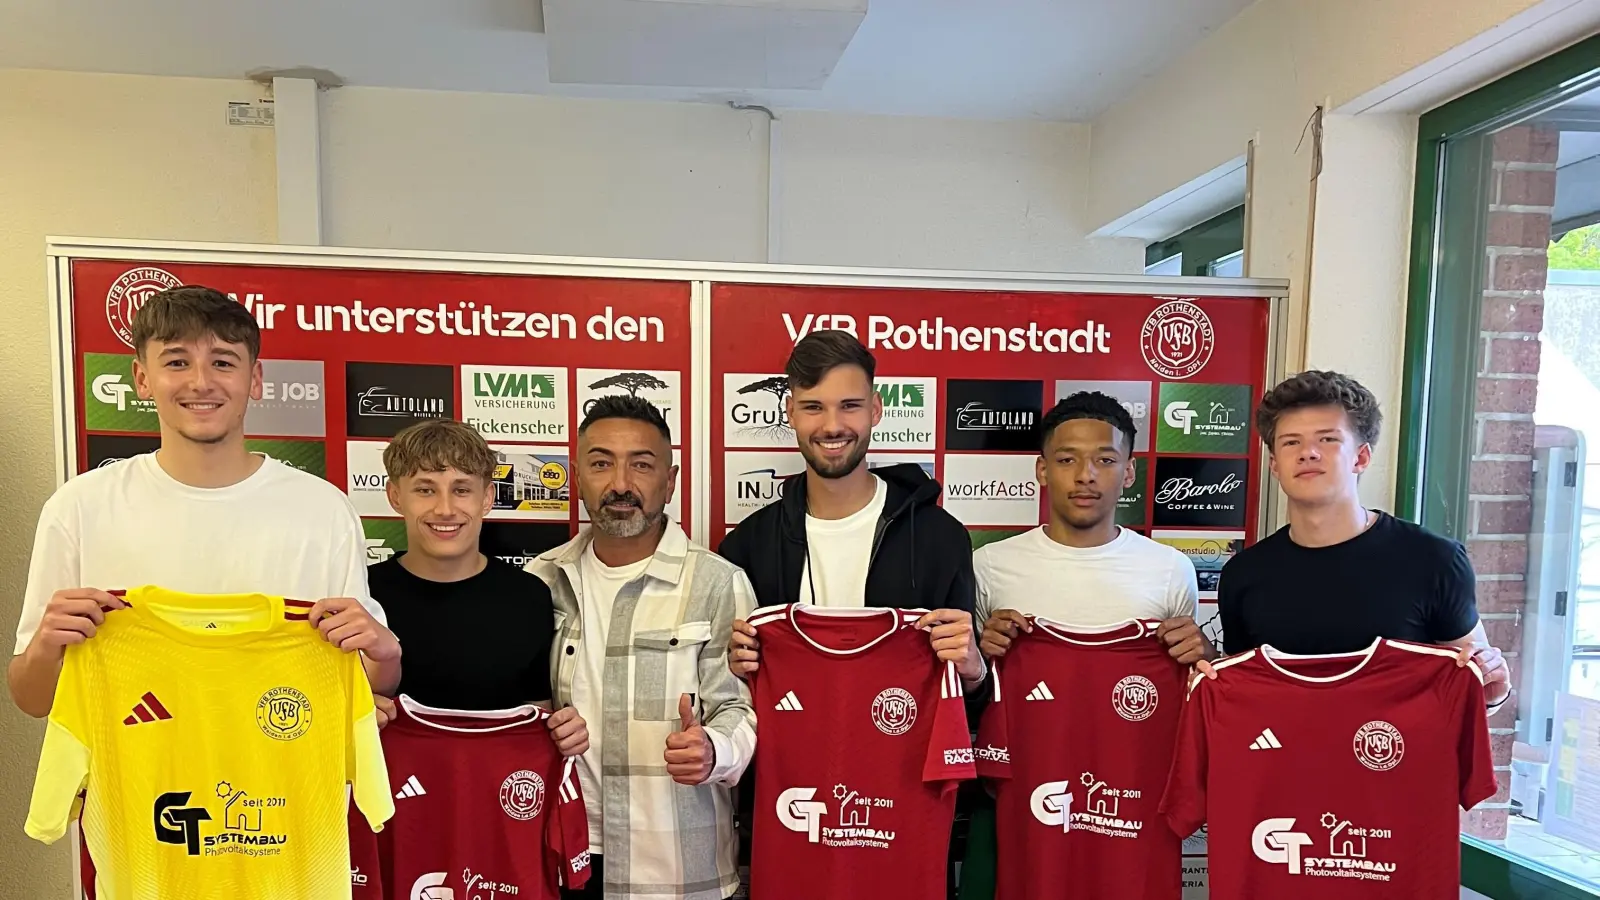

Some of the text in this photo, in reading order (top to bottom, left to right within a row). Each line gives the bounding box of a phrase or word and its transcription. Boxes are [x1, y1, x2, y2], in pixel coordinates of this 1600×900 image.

[228, 293, 665, 343] ir unterstützen den
[1143, 304, 1212, 342] VFB ROTHENSTADT
[868, 314, 1111, 354] Rothenstadt
[1163, 322, 1191, 351] VfB
[92, 374, 133, 411] GT
[262, 382, 320, 402] E JOB
[473, 372, 529, 398] LVM
[386, 396, 444, 413] AUTOLAND
[474, 399, 556, 410] VERSICHERUNG
[884, 409, 925, 418] HERUNG
[981, 411, 1034, 425] AUTOLAND
[1163, 401, 1199, 435] GT
[871, 428, 932, 443] enscher
[353, 474, 388, 487] wor
[948, 480, 1036, 497] workfActS
[1155, 473, 1244, 504] Barolo
[1102, 788, 1141, 799] seit 2011
[243, 798, 286, 807] seit 2011
[854, 797, 894, 808] seit 2011
[1030, 780, 1074, 834] GT
[154, 791, 213, 856] GT
[776, 787, 828, 843] GT
[204, 833, 287, 846] SYSTEMBAU
[822, 827, 895, 840] SYSTEMBAU
[1347, 826, 1392, 839] seit 2011
[1251, 817, 1314, 875] GT
[1303, 857, 1397, 873] SYSTEMBAU
[478, 881, 519, 894] seit 2011
[1182, 880, 1205, 888] ERIA
